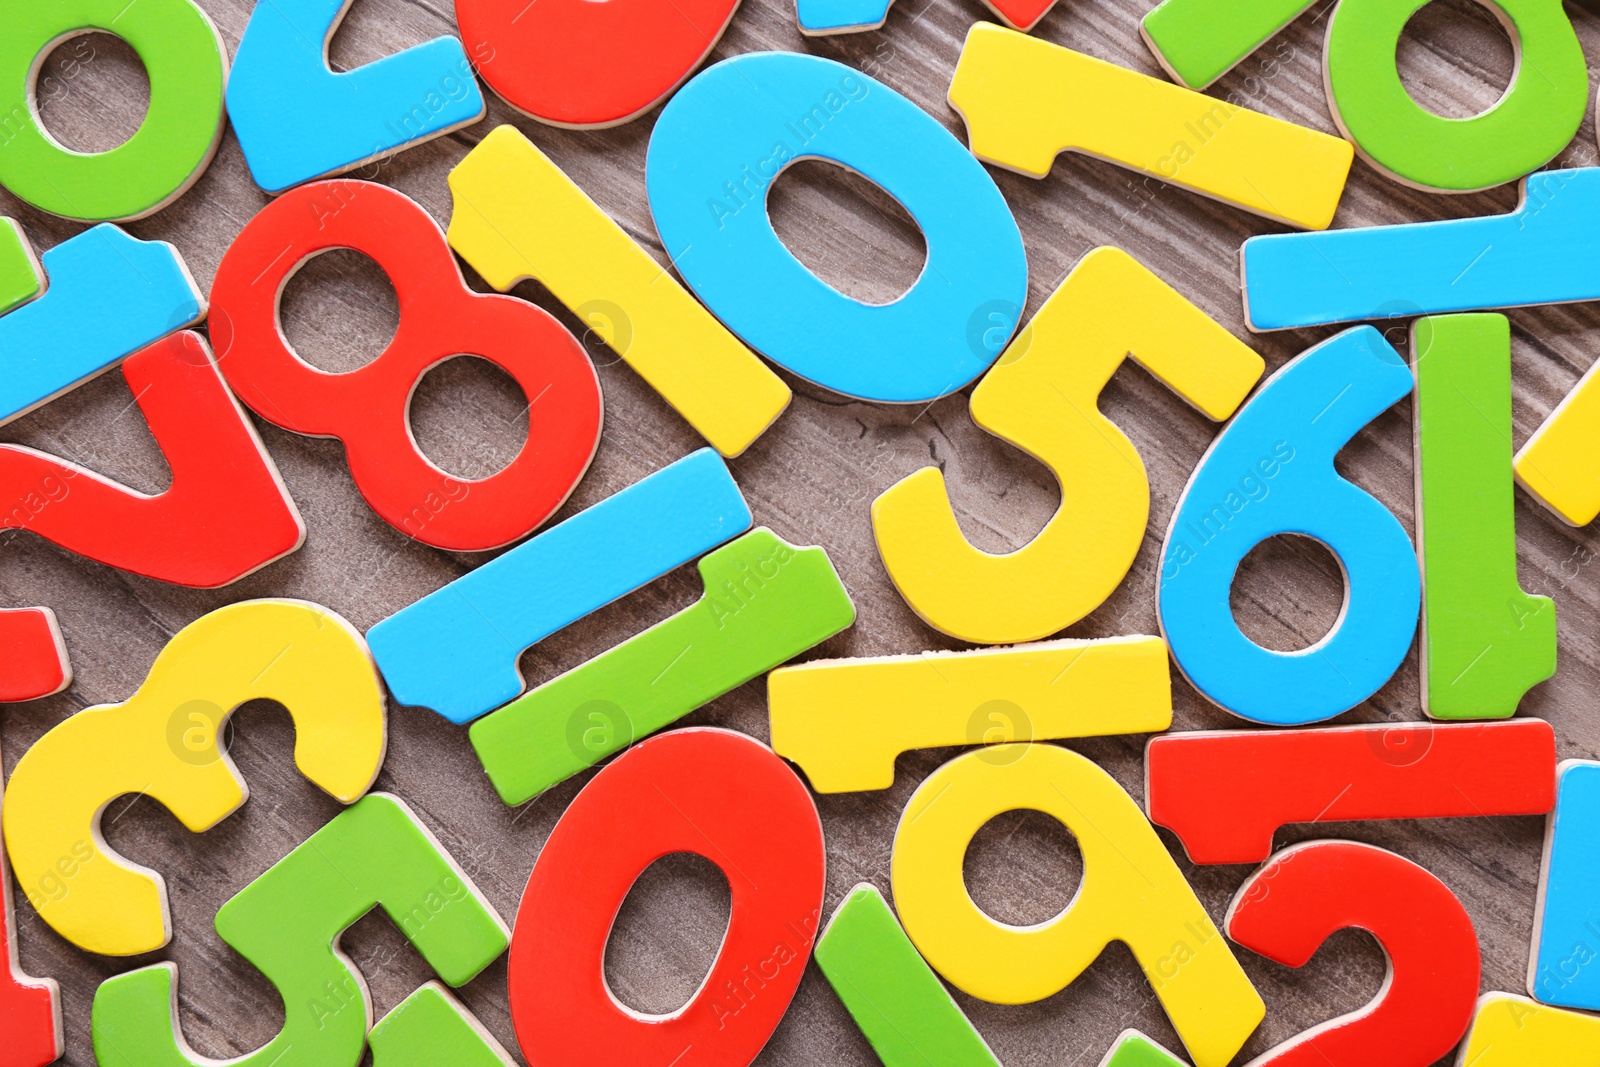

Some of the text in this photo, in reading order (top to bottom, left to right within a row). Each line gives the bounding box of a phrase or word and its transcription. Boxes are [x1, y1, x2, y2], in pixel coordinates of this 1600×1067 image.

[447, 123, 792, 458] 1
[645, 50, 1028, 405] 0
[947, 20, 1354, 230] 1
[208, 178, 604, 552] 8
[871, 245, 1266, 645] 5
[1155, 324, 1422, 726] 6
[1410, 312, 1557, 722] 1
[367, 446, 754, 726] 1
[468, 526, 857, 807] 1
[767, 634, 1173, 794] 1
[2, 597, 388, 957] 3
[91, 791, 511, 1067] 5
[507, 727, 827, 1067] 0
[890, 742, 1266, 1067] 9
[1144, 717, 1556, 865] 1
